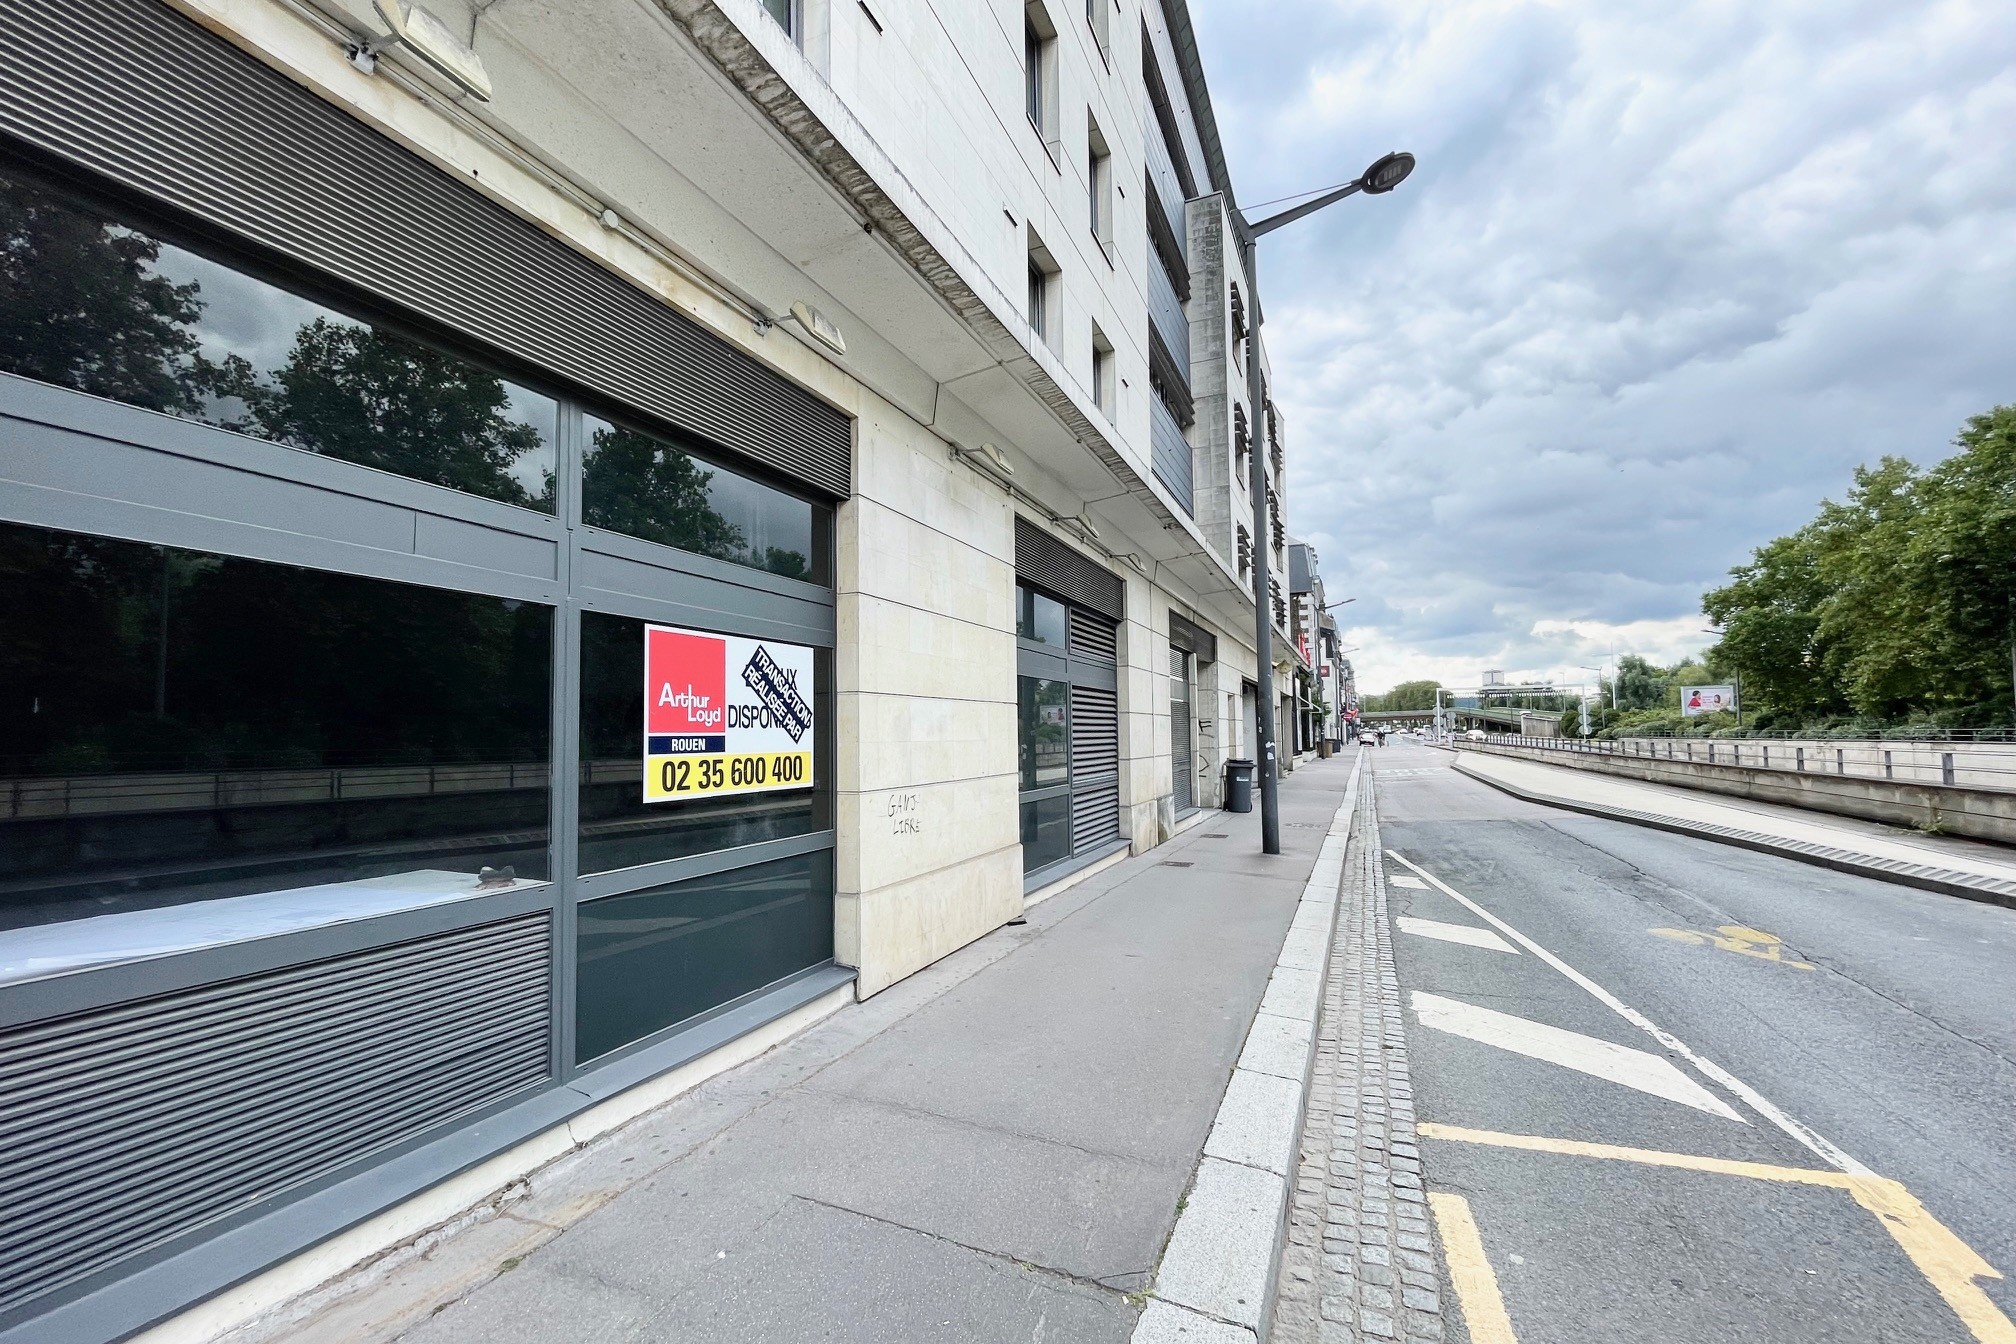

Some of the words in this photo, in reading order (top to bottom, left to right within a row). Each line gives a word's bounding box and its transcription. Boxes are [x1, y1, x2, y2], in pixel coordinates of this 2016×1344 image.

[658, 682, 710, 708] Arthur
[745, 665, 787, 721] RÉALISÉE
[783, 714, 802, 740] PAR
[756, 648, 811, 726] TRANSACTION
[687, 702, 721, 727] Loyd
[671, 738, 706, 752] ROUEN
[662, 760, 690, 792] 02
[698, 759, 724, 789] 35
[731, 757, 766, 786] 600
[772, 755, 802, 782] 400
